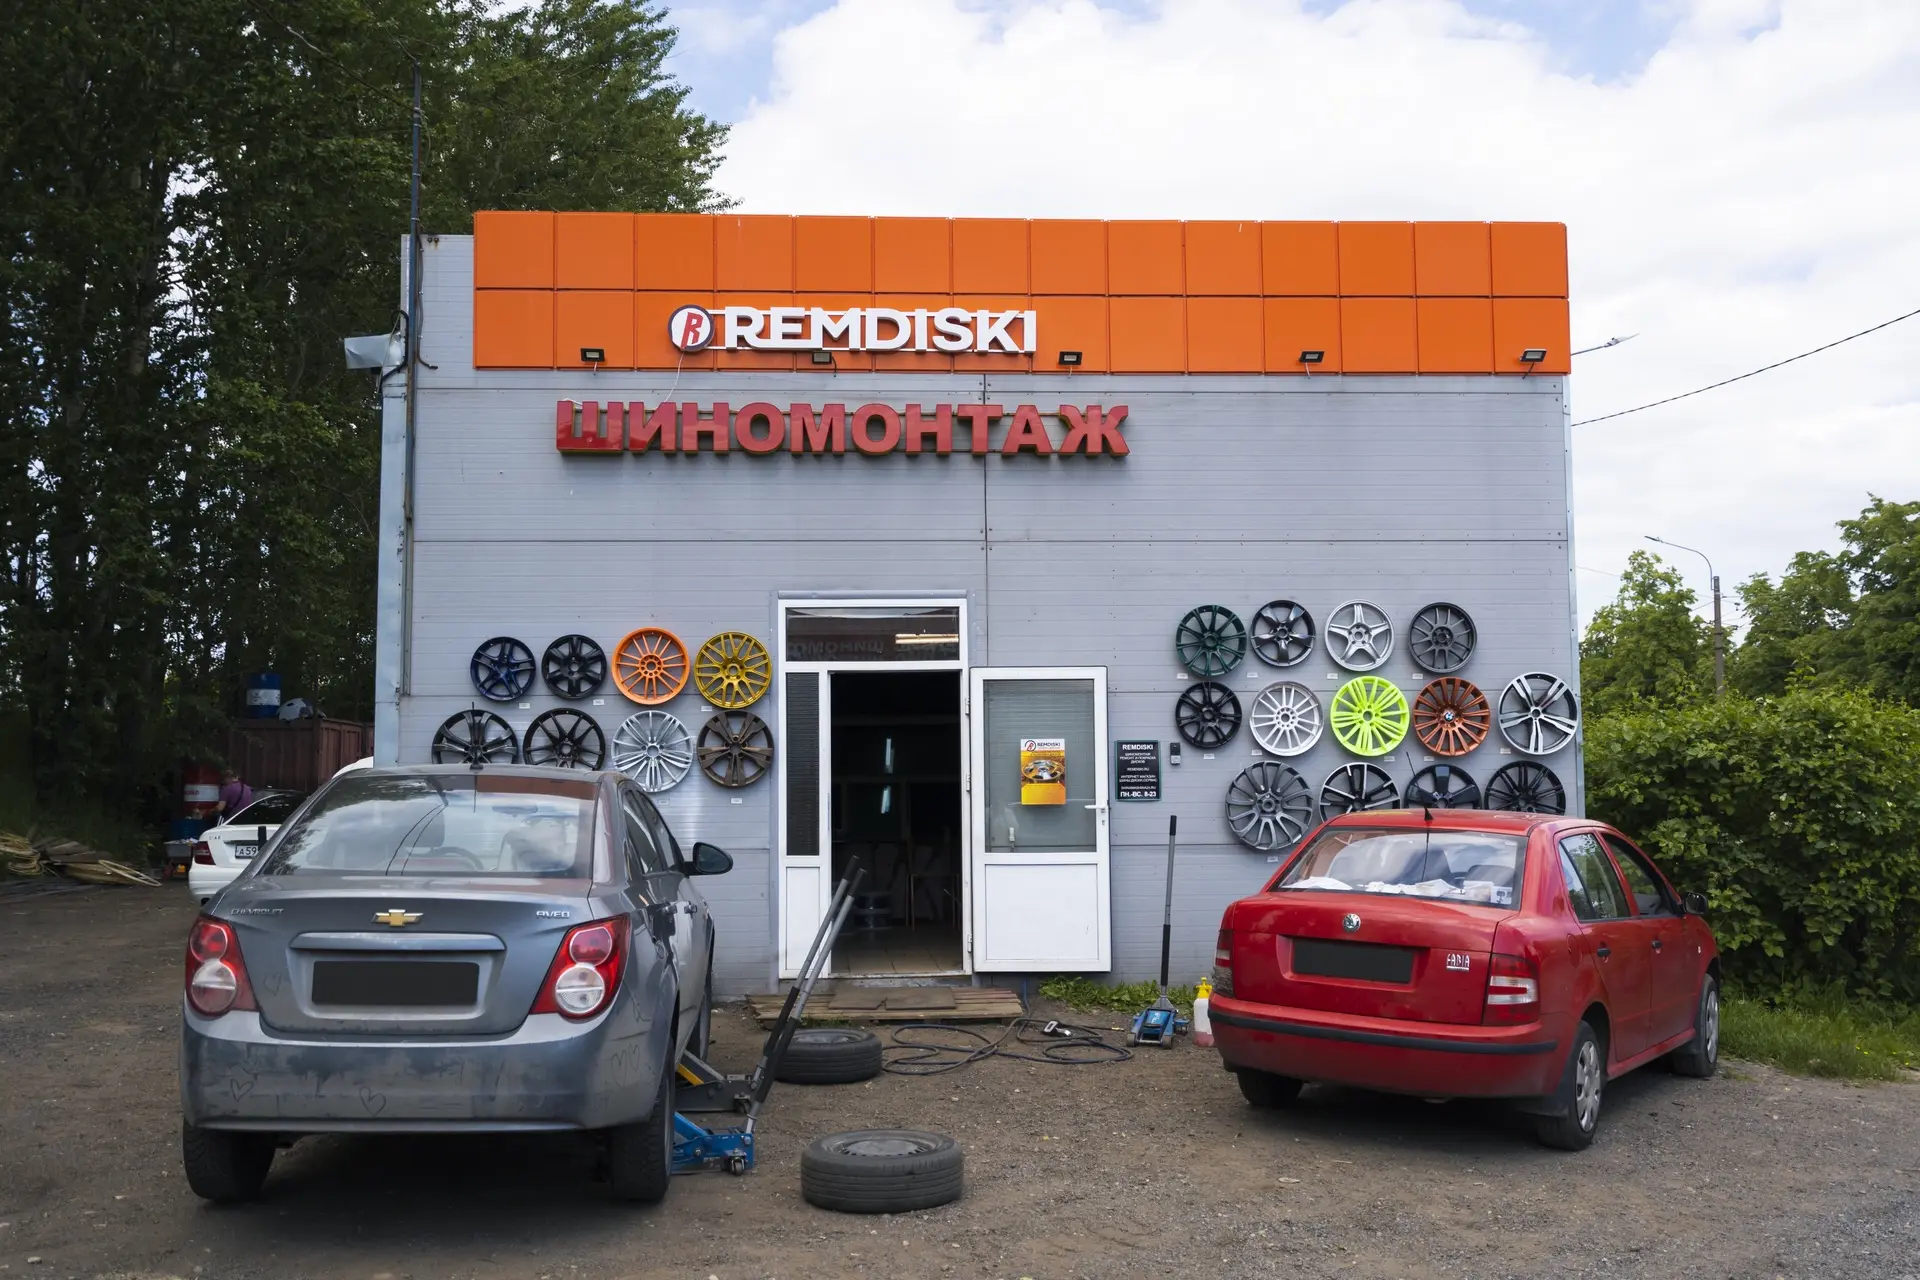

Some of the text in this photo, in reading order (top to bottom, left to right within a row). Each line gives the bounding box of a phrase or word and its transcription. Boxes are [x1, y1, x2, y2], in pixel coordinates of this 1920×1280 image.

[724, 306, 1037, 352] REMDISKI
[556, 400, 1131, 456] ШИНОМОНТАЖ
[230, 908, 285, 916] CHEVROLET
[536, 910, 571, 918] AVEO
[1446, 953, 1470, 968] FABIA
